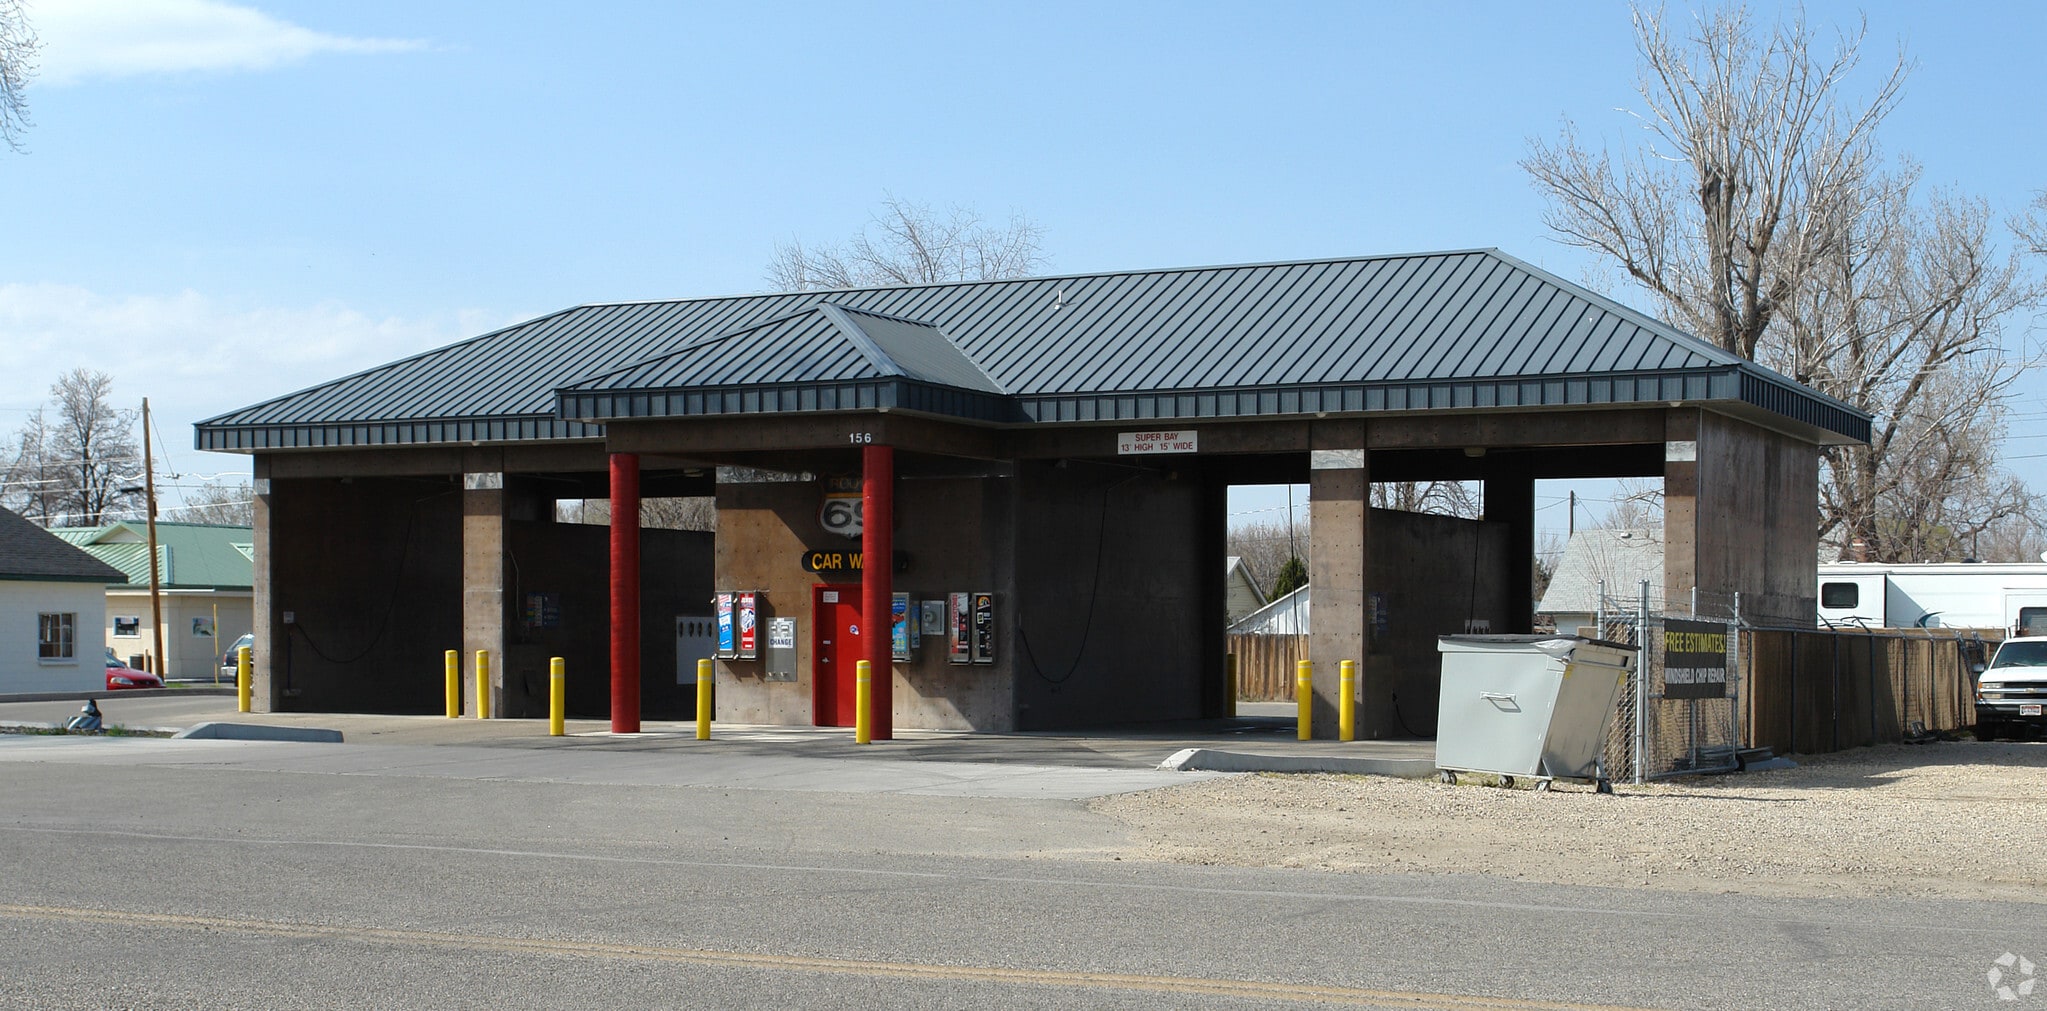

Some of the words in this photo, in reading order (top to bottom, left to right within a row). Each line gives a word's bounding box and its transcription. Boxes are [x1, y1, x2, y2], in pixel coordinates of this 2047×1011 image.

[849, 432, 872, 444] 156
[1135, 433, 1161, 442] SUPER
[1164, 432, 1179, 441] BAY
[1134, 443, 1154, 452] HIGH
[1173, 441, 1193, 450] WIDE
[831, 479, 863, 489] ROU
[812, 553, 842, 570] CAR
[769, 638, 792, 646] CHANGE
[1665, 631, 1684, 652] FREE
[1685, 632, 1726, 654] ESTIMATES!
[1664, 667, 1695, 684] WINDSHIELD
[1695, 667, 1707, 684] CHIP
[1707, 667, 1726, 684] REPAIR
